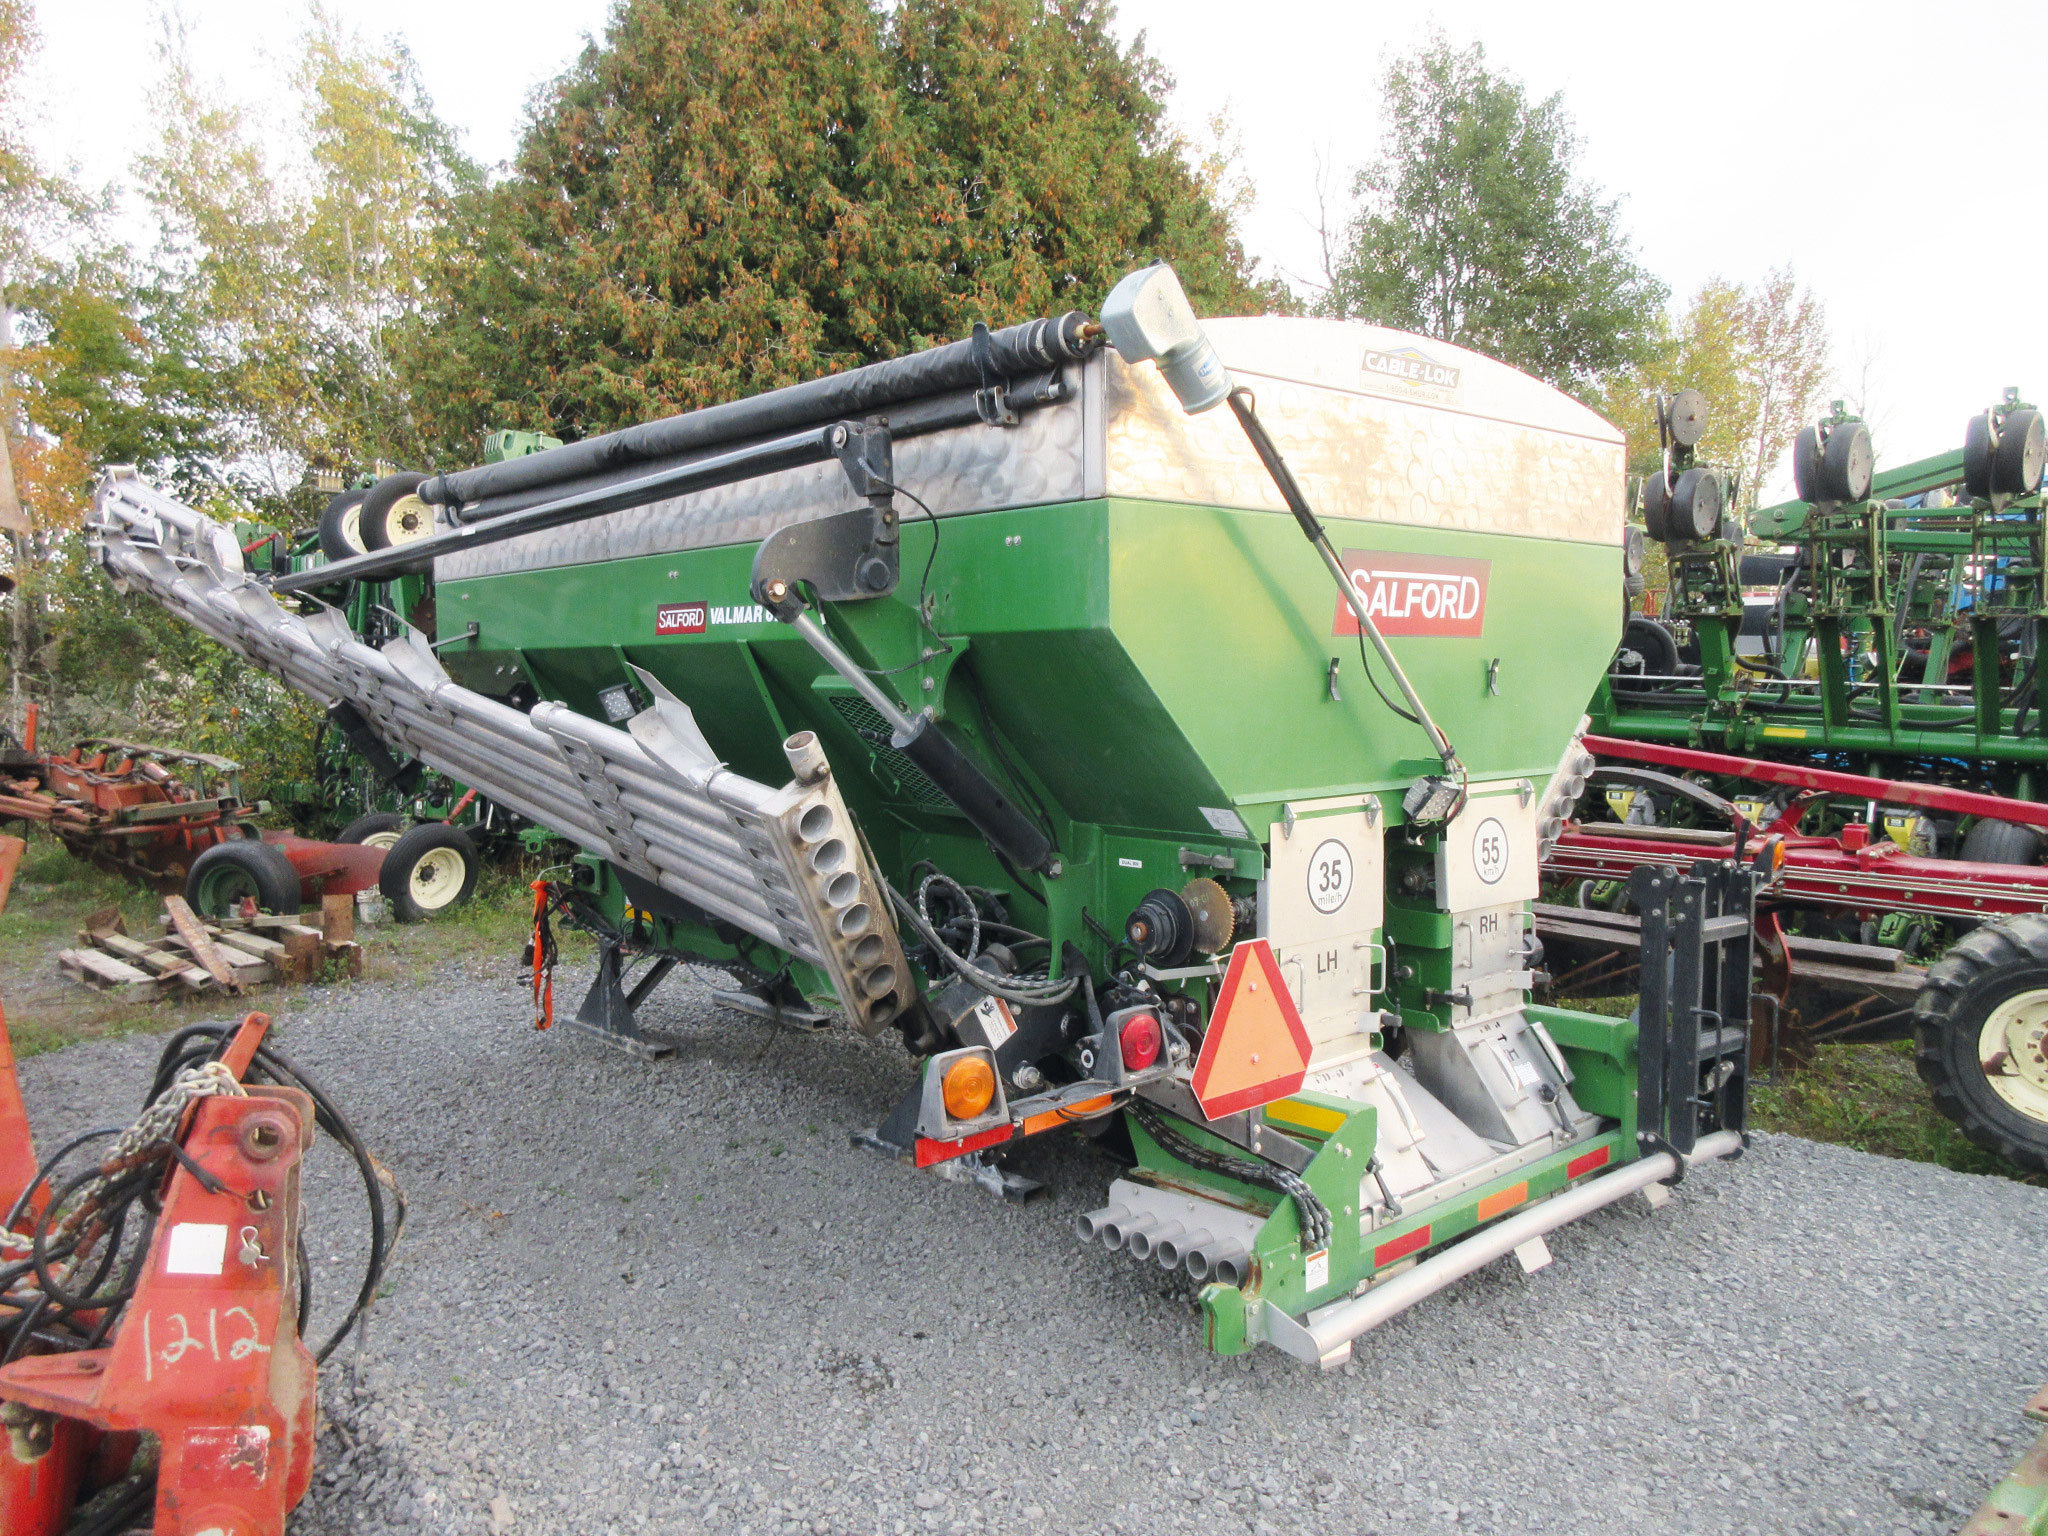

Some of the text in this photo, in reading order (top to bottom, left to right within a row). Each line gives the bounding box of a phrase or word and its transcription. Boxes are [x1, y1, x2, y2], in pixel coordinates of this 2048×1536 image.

[1365, 352, 1457, 386] CABLE-LOK
[1346, 568, 1480, 620] SALFORD
[658, 607, 705, 629] SALFORD
[710, 605, 763, 625] VALMAR
[1482, 836, 1500, 866] 55
[1319, 859, 1342, 892] 35
[1317, 892, 1343, 906] mile/h
[1480, 912, 1498, 935] RH
[1317, 949, 1338, 974] LH
[144, 1306, 272, 1382] 1212
